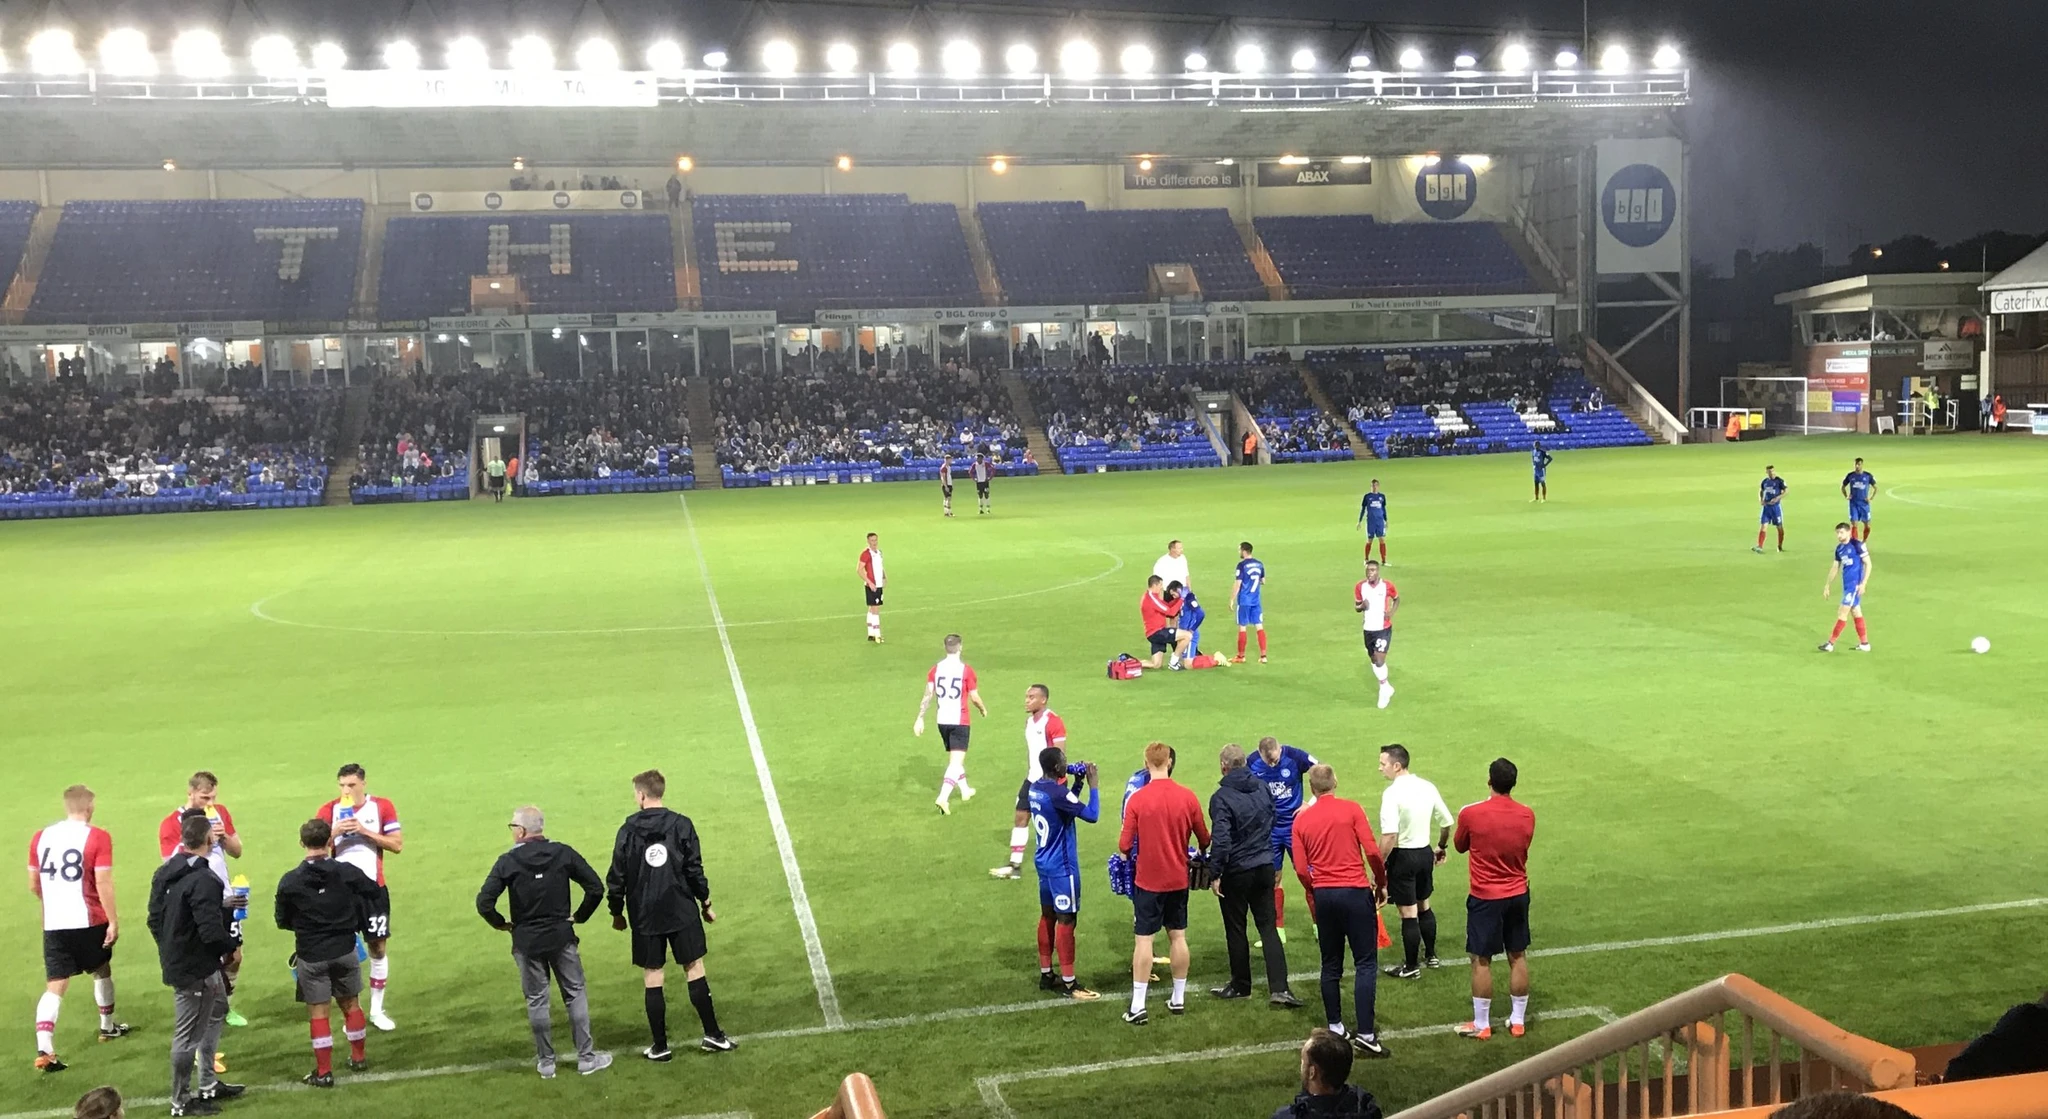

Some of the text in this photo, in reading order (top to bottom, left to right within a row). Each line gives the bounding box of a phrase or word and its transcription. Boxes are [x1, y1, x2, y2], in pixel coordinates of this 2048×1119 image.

[1134, 173, 1231, 186] The difference is
[1296, 171, 1329, 183] ABAX
[1429, 183, 1461, 198] bgl
[1618, 200, 1656, 218] bgl
[968, 310, 996, 319] Group
[88, 326, 128, 336] SWITCH
[1250, 574, 1260, 593] 7
[936, 676, 962, 700] 55
[649, 848, 664, 858] EA
[40, 847, 83, 882] 48
[368, 915, 387, 933] 32
